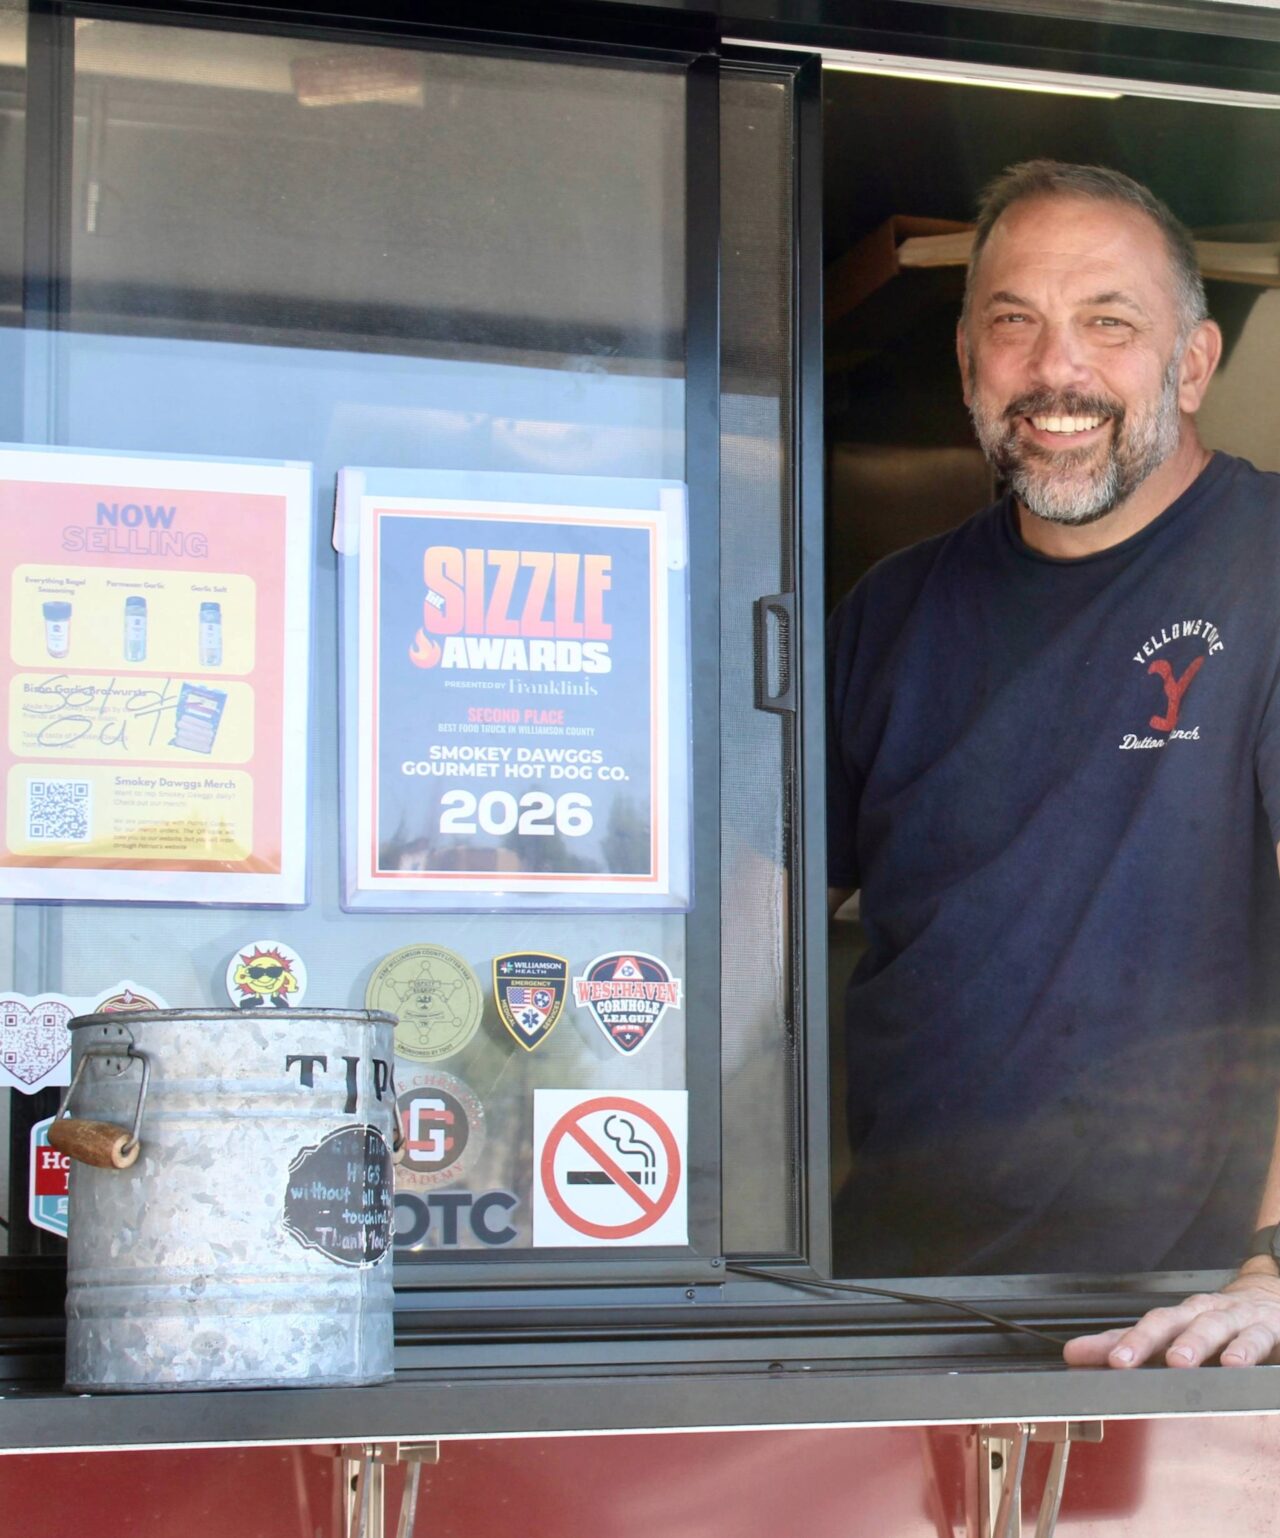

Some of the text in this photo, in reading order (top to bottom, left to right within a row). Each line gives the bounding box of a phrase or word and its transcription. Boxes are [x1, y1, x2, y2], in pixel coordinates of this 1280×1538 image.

[96, 503, 176, 529] NOW
[62, 526, 208, 558] SELLING
[25, 576, 64, 586] Everything
[423, 546, 612, 640] SIZZLE
[441, 636, 612, 673] AWARDS
[444, 680, 506, 690] PRESENTED BY
[468, 708, 565, 724] SECOND PLACE
[438, 724, 594, 737] BEST FOOD TRUCK IN WILLIAMSON COUNTY
[1119, 734, 1165, 750] Dutton
[429, 745, 603, 763] SMOKEY DAWGGS
[401, 761, 630, 781] GOURMET HOT DOG CO.
[115, 776, 236, 789] Smokey Dawggs Merch
[440, 789, 594, 835] 2026
[577, 981, 678, 1002] WESTHAVEN
[501, 999, 515, 1027] MEDICAL
[543, 1001, 561, 1029] SERVICES
[597, 1001, 659, 1015] CORNHOLE
[604, 1014, 654, 1023] LEAGUE
[291, 1182, 351, 1203] without
